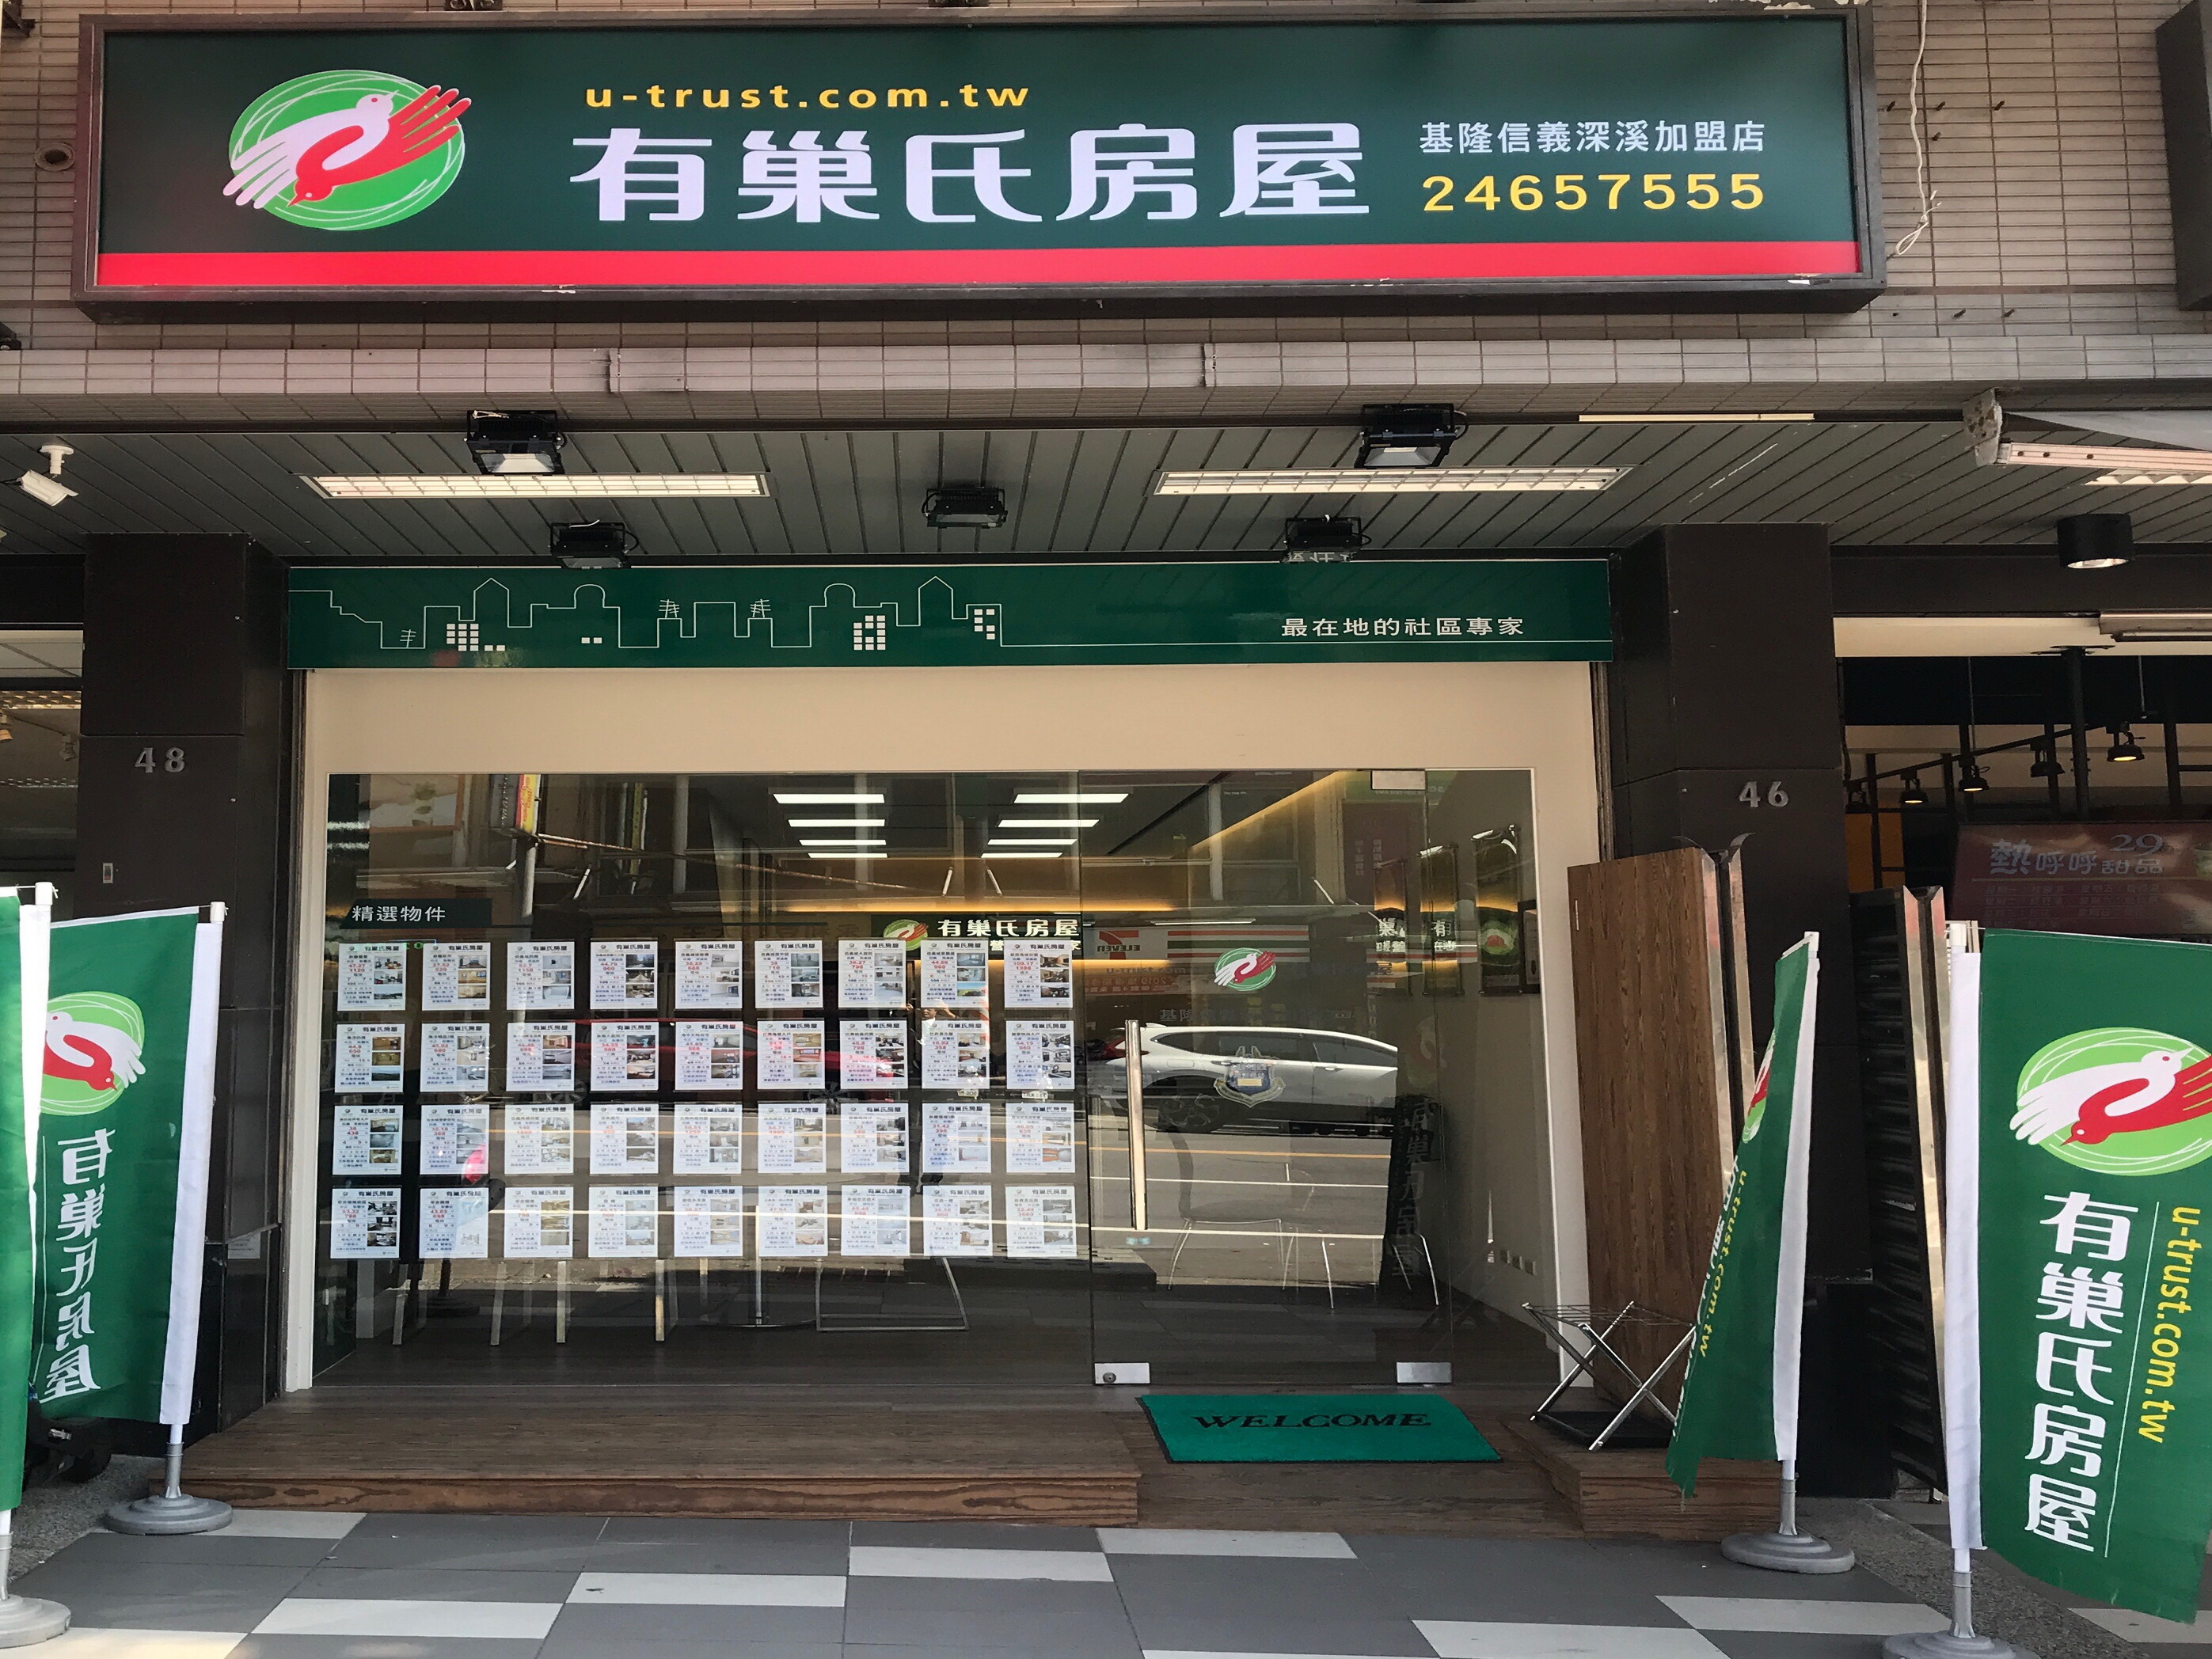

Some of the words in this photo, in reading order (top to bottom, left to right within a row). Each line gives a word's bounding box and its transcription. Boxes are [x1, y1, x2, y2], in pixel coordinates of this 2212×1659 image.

[585, 82, 1030, 110] u-trust.com.tw
[1419, 120, 1766, 155] 基隆信義深溪加盟店
[569, 123, 1371, 223] 有巢氏房屋
[1422, 172, 1765, 214] 24657555
[1280, 616, 1525, 637] 最在地的社區專家
[134, 746, 187, 774] 48
[1738, 780, 1789, 808] 46
[2109, 833, 2164, 857] 29
[352, 905, 447, 923] 精選物件
[937, 918, 1080, 937] 有巢氏房屋
[1700, 1169, 1748, 1358] u-trust.com.tw
[2138, 1205, 2202, 1445] u-trust.com.tw
[2024, 1190, 2139, 1552] 有巢氏房屋
[1192, 1413, 1432, 1429] WELCOME
